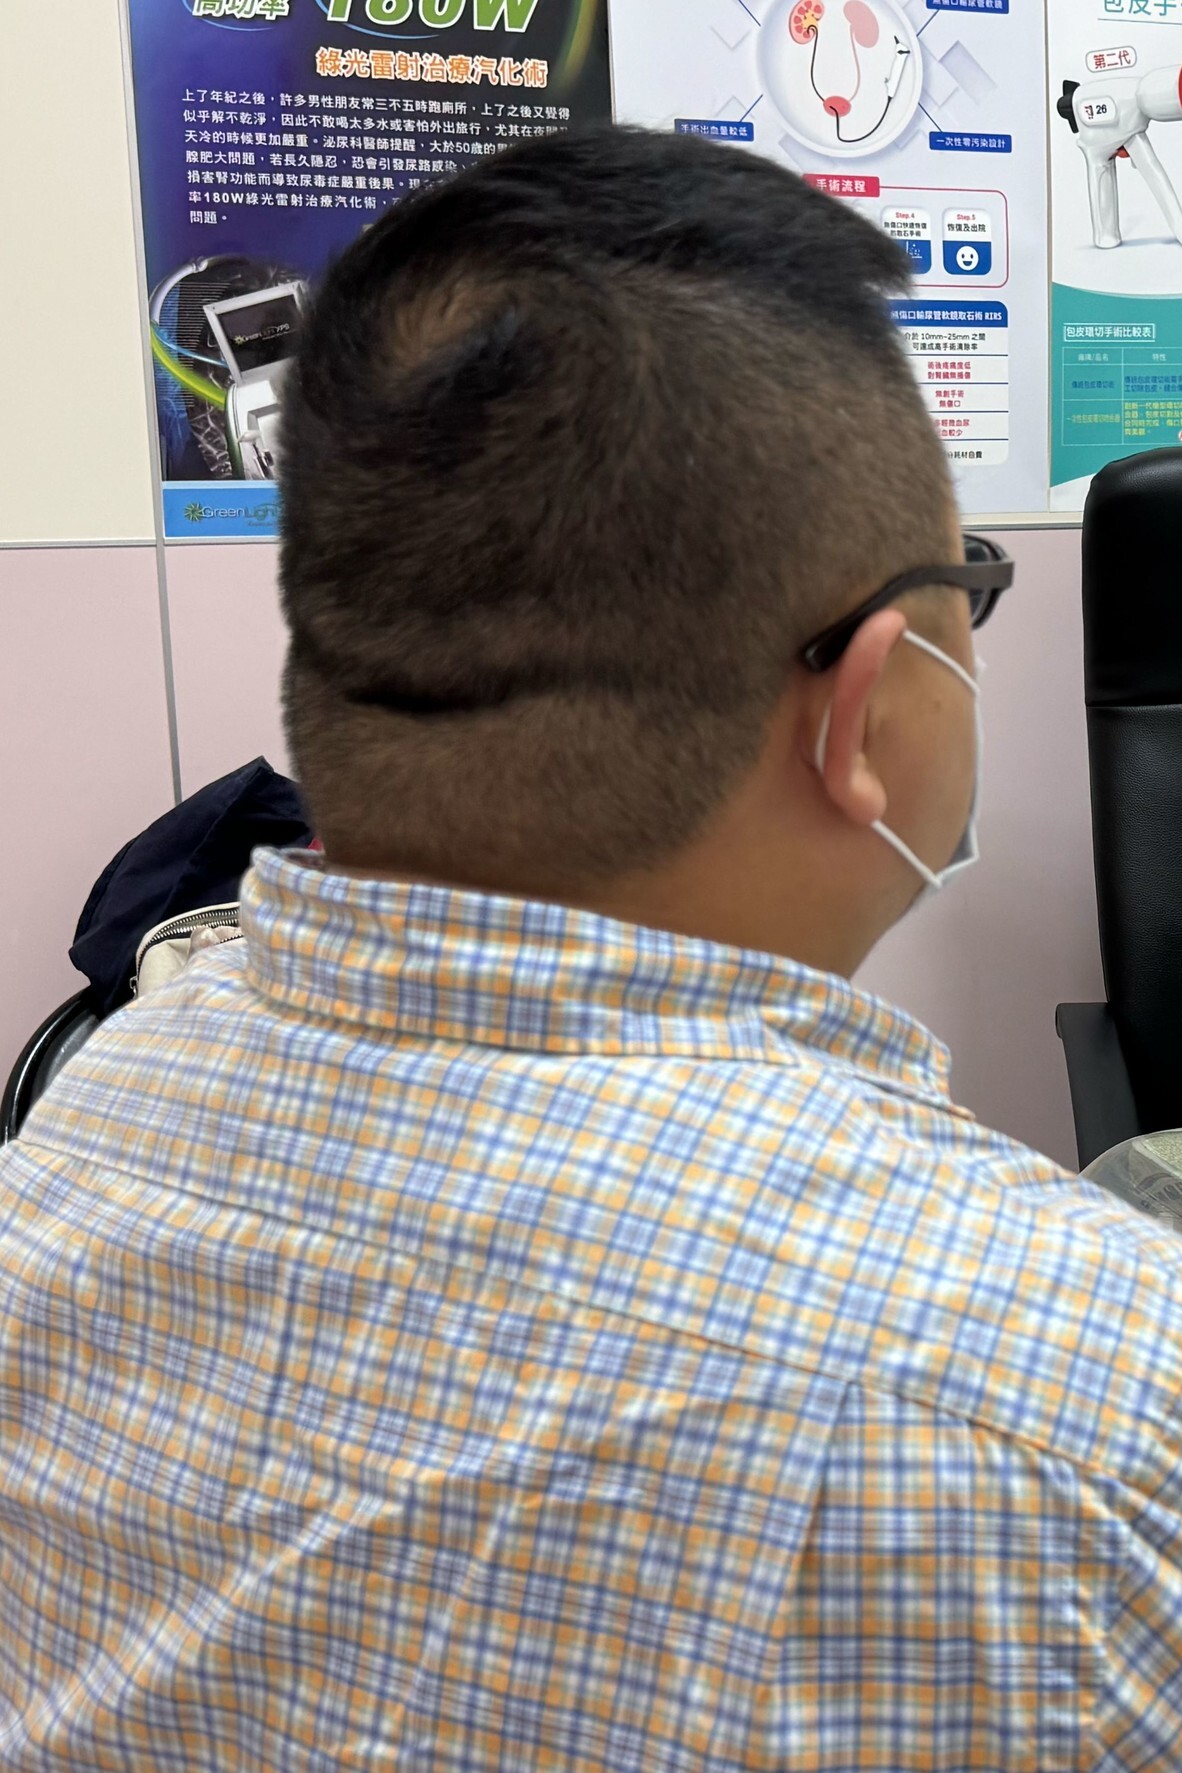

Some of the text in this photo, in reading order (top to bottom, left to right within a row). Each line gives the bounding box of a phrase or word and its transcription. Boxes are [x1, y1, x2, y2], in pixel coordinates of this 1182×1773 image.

[1093, 50, 1131, 69] 第二代
[316, 47, 549, 88] 綠光雷射治療汽化術
[1095, 104, 1108, 115] 26
[936, 137, 1007, 149] 一次性零污染設計
[816, 178, 867, 193] 手術流程
[1066, 326, 1153, 338] 包皮環切手術比較表
